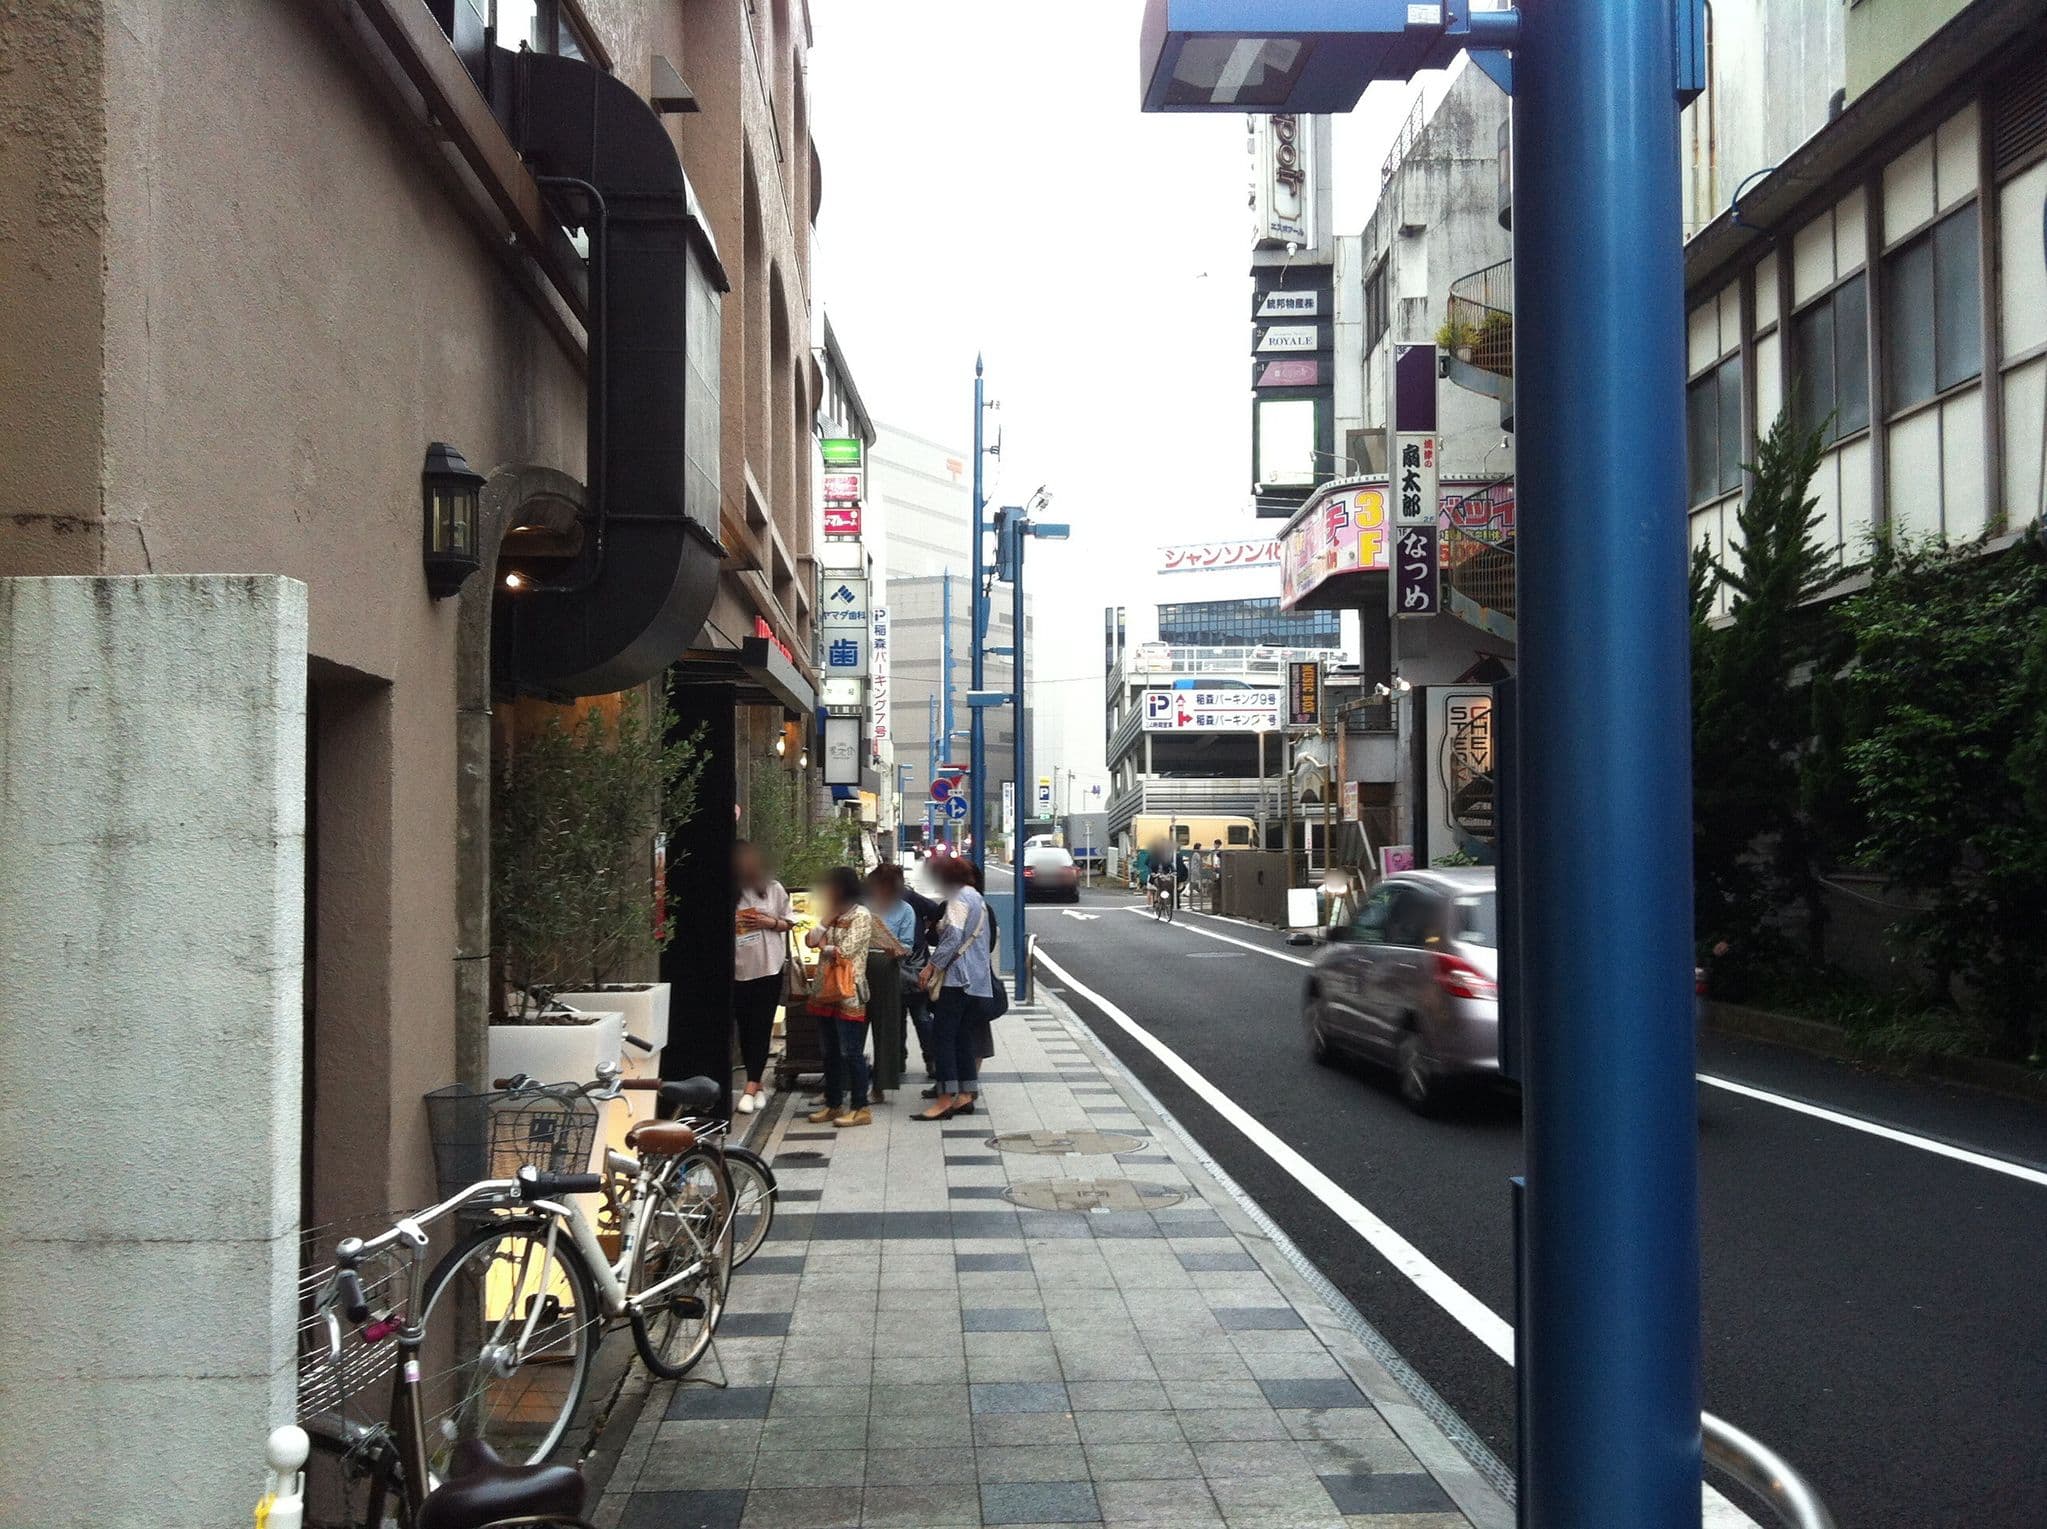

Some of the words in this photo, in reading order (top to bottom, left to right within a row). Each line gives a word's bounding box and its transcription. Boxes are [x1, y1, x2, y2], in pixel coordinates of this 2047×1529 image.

[1268, 337, 1313, 346] ROYALE
[1165, 542, 1280, 568] シャンソン化
[1404, 533, 1430, 611] なつめ
[829, 639, 858, 667] 歯
[1302, 664, 1315, 692] MUSIC
[1196, 693, 1277, 706] 稲森パーキング9号
[1302, 695, 1315, 713] BOX
[1196, 714, 1277, 726] 稲森パーキング号
[1041, 788, 1049, 799] P
